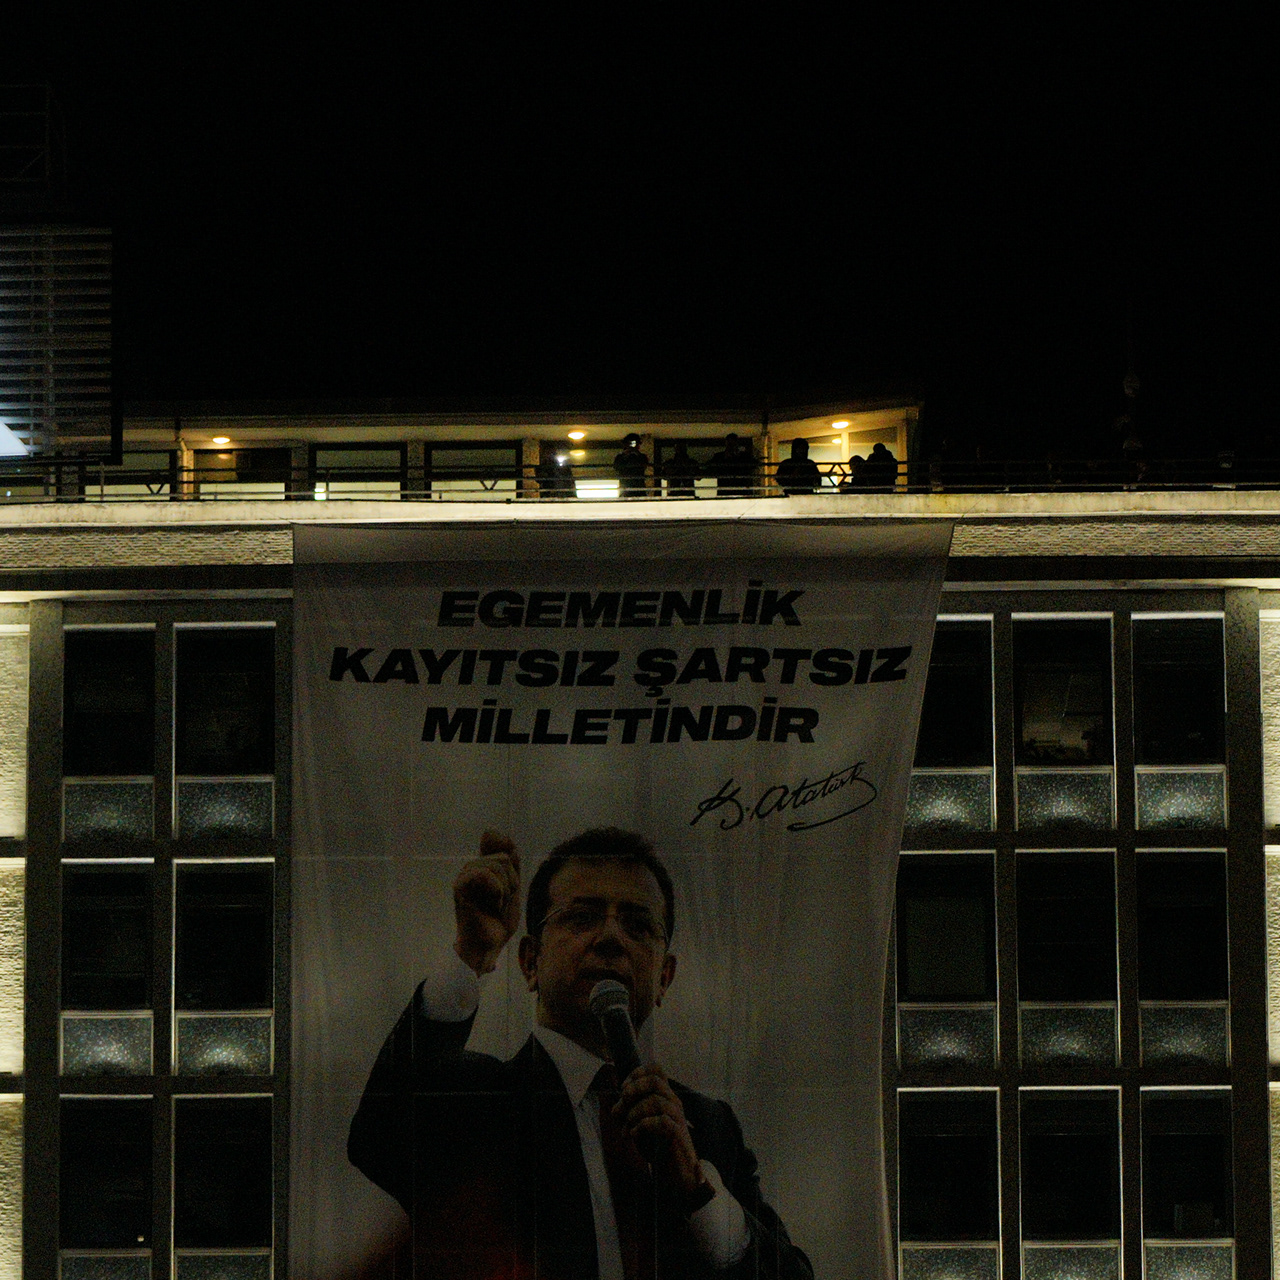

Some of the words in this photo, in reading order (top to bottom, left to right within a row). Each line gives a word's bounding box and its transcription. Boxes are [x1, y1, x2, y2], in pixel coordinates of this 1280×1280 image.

[436, 580, 806, 629] EGEMENLİK
[328, 645, 618, 688] KAYITSIZ
[633, 644, 913, 697] ŞARTSIZ
[420, 697, 820, 745] MİLLETİNDİR
